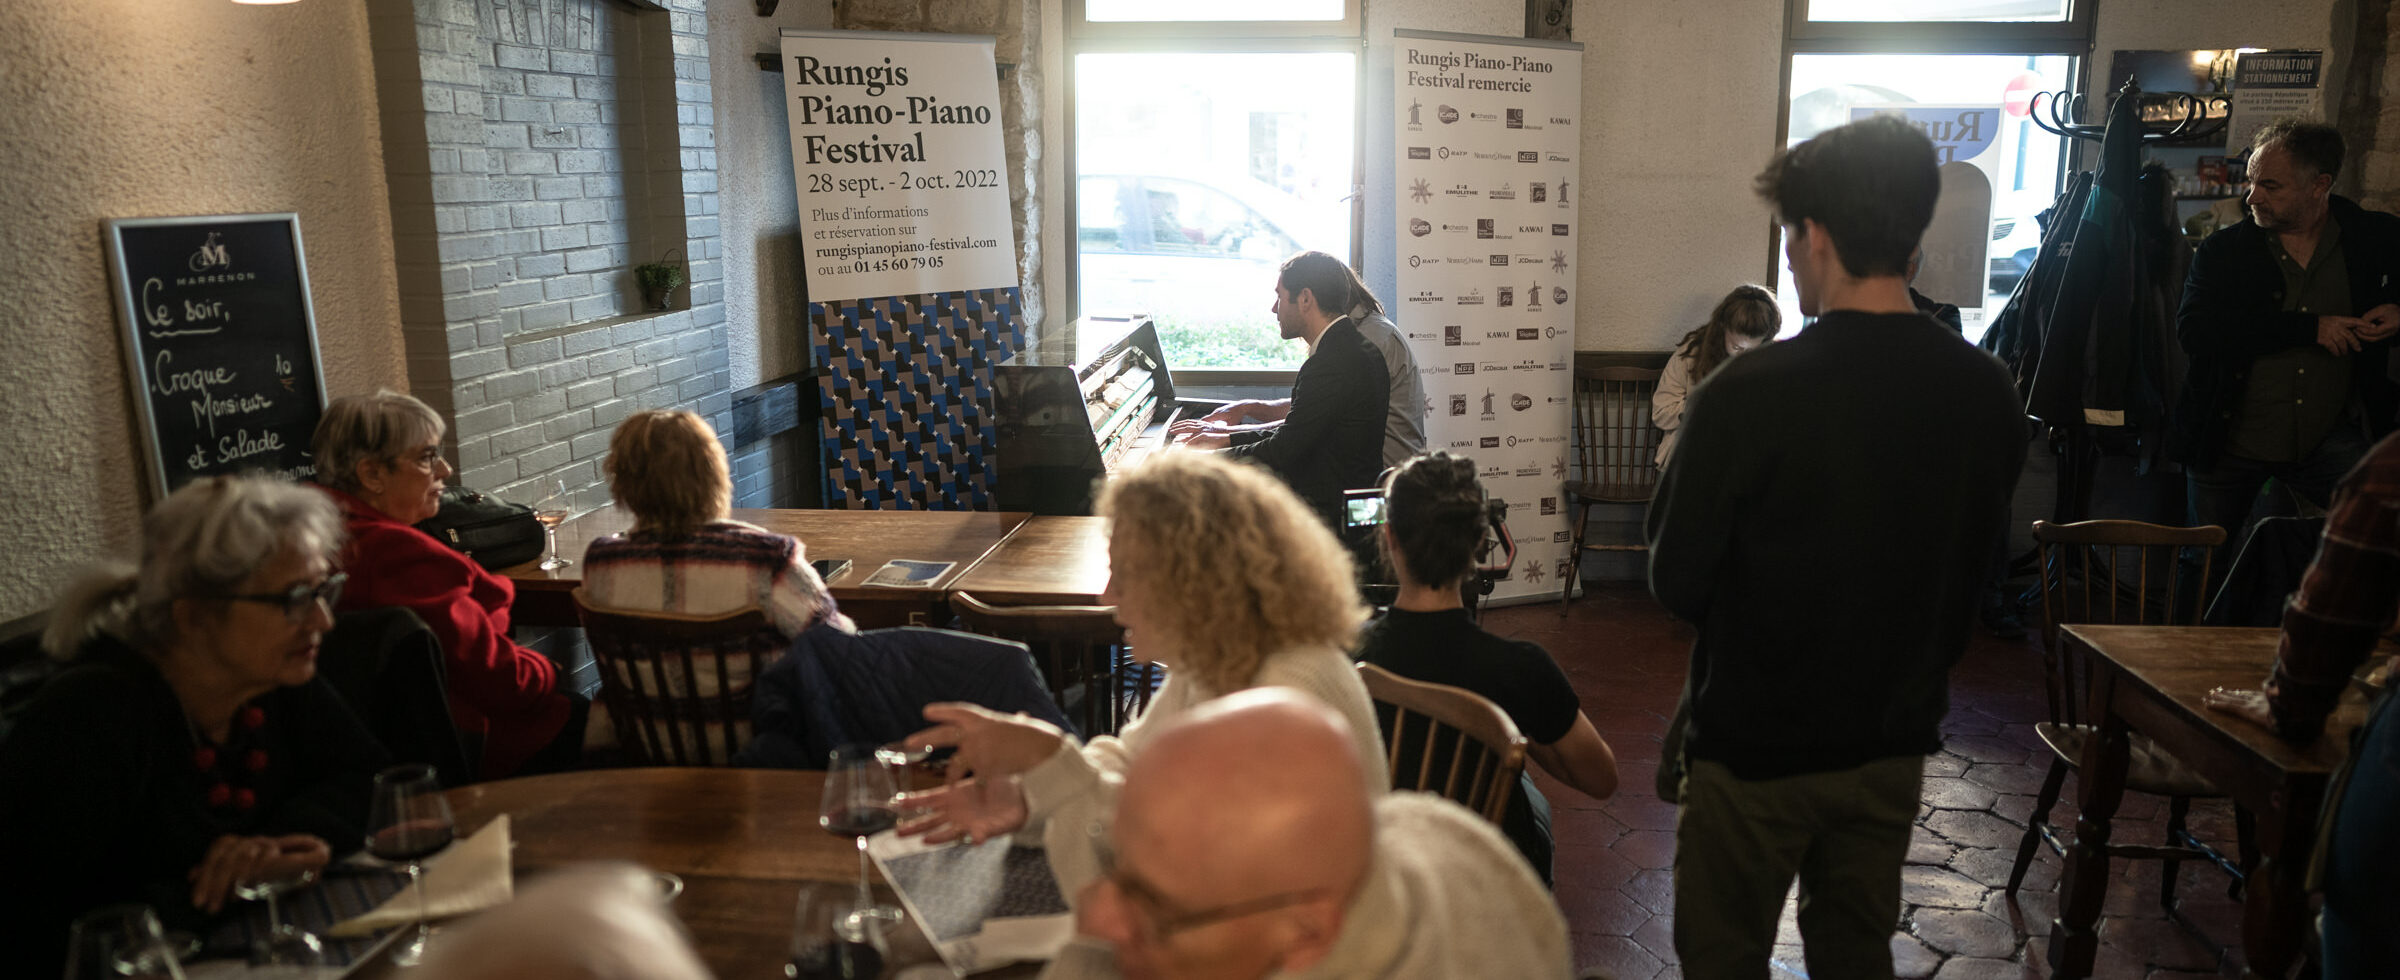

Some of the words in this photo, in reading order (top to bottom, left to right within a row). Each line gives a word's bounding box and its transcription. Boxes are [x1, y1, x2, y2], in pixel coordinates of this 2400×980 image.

[1408, 49, 1460, 72] Rungis
[1464, 53, 1553, 73] Piano-Piano
[2245, 58, 2314, 71] INFORMATION
[795, 56, 908, 96] Rungis
[1408, 71, 1465, 88] Festival
[1468, 78, 1532, 92] remercie
[2244, 73, 2312, 83] STATIONNEMENT
[799, 95, 991, 125] Piano-Piano
[1550, 117, 1571, 126] KAWAI
[803, 132, 926, 164] Festival
[808, 173, 833, 192] 28
[839, 175, 884, 198] sept.
[900, 172, 910, 189] 2
[915, 174, 950, 190] oct.
[954, 170, 998, 188] 2022
[812, 209, 839, 222] Plus
[842, 206, 929, 220] d'informations
[814, 229, 826, 240] et
[829, 225, 896, 240] réservation
[899, 226, 917, 237] sur
[816, 237, 997, 260] rungispianopiano-festival.com
[818, 265, 834, 276] ou
[837, 263, 851, 274] au
[854, 261, 870, 273] 01
[873, 260, 888, 273] 45
[891, 258, 908, 270] 60
[911, 257, 926, 269] 79
[929, 256, 944, 268] 05
[177, 273, 255, 285] MARRENON
[143, 278, 173, 325] Ce
[1487, 331, 1510, 339] KAWAI
[156, 350, 237, 396] Croque
[191, 393, 272, 438] Monsieur
[188, 444, 208, 469] et
[218, 429, 285, 463] Salade
